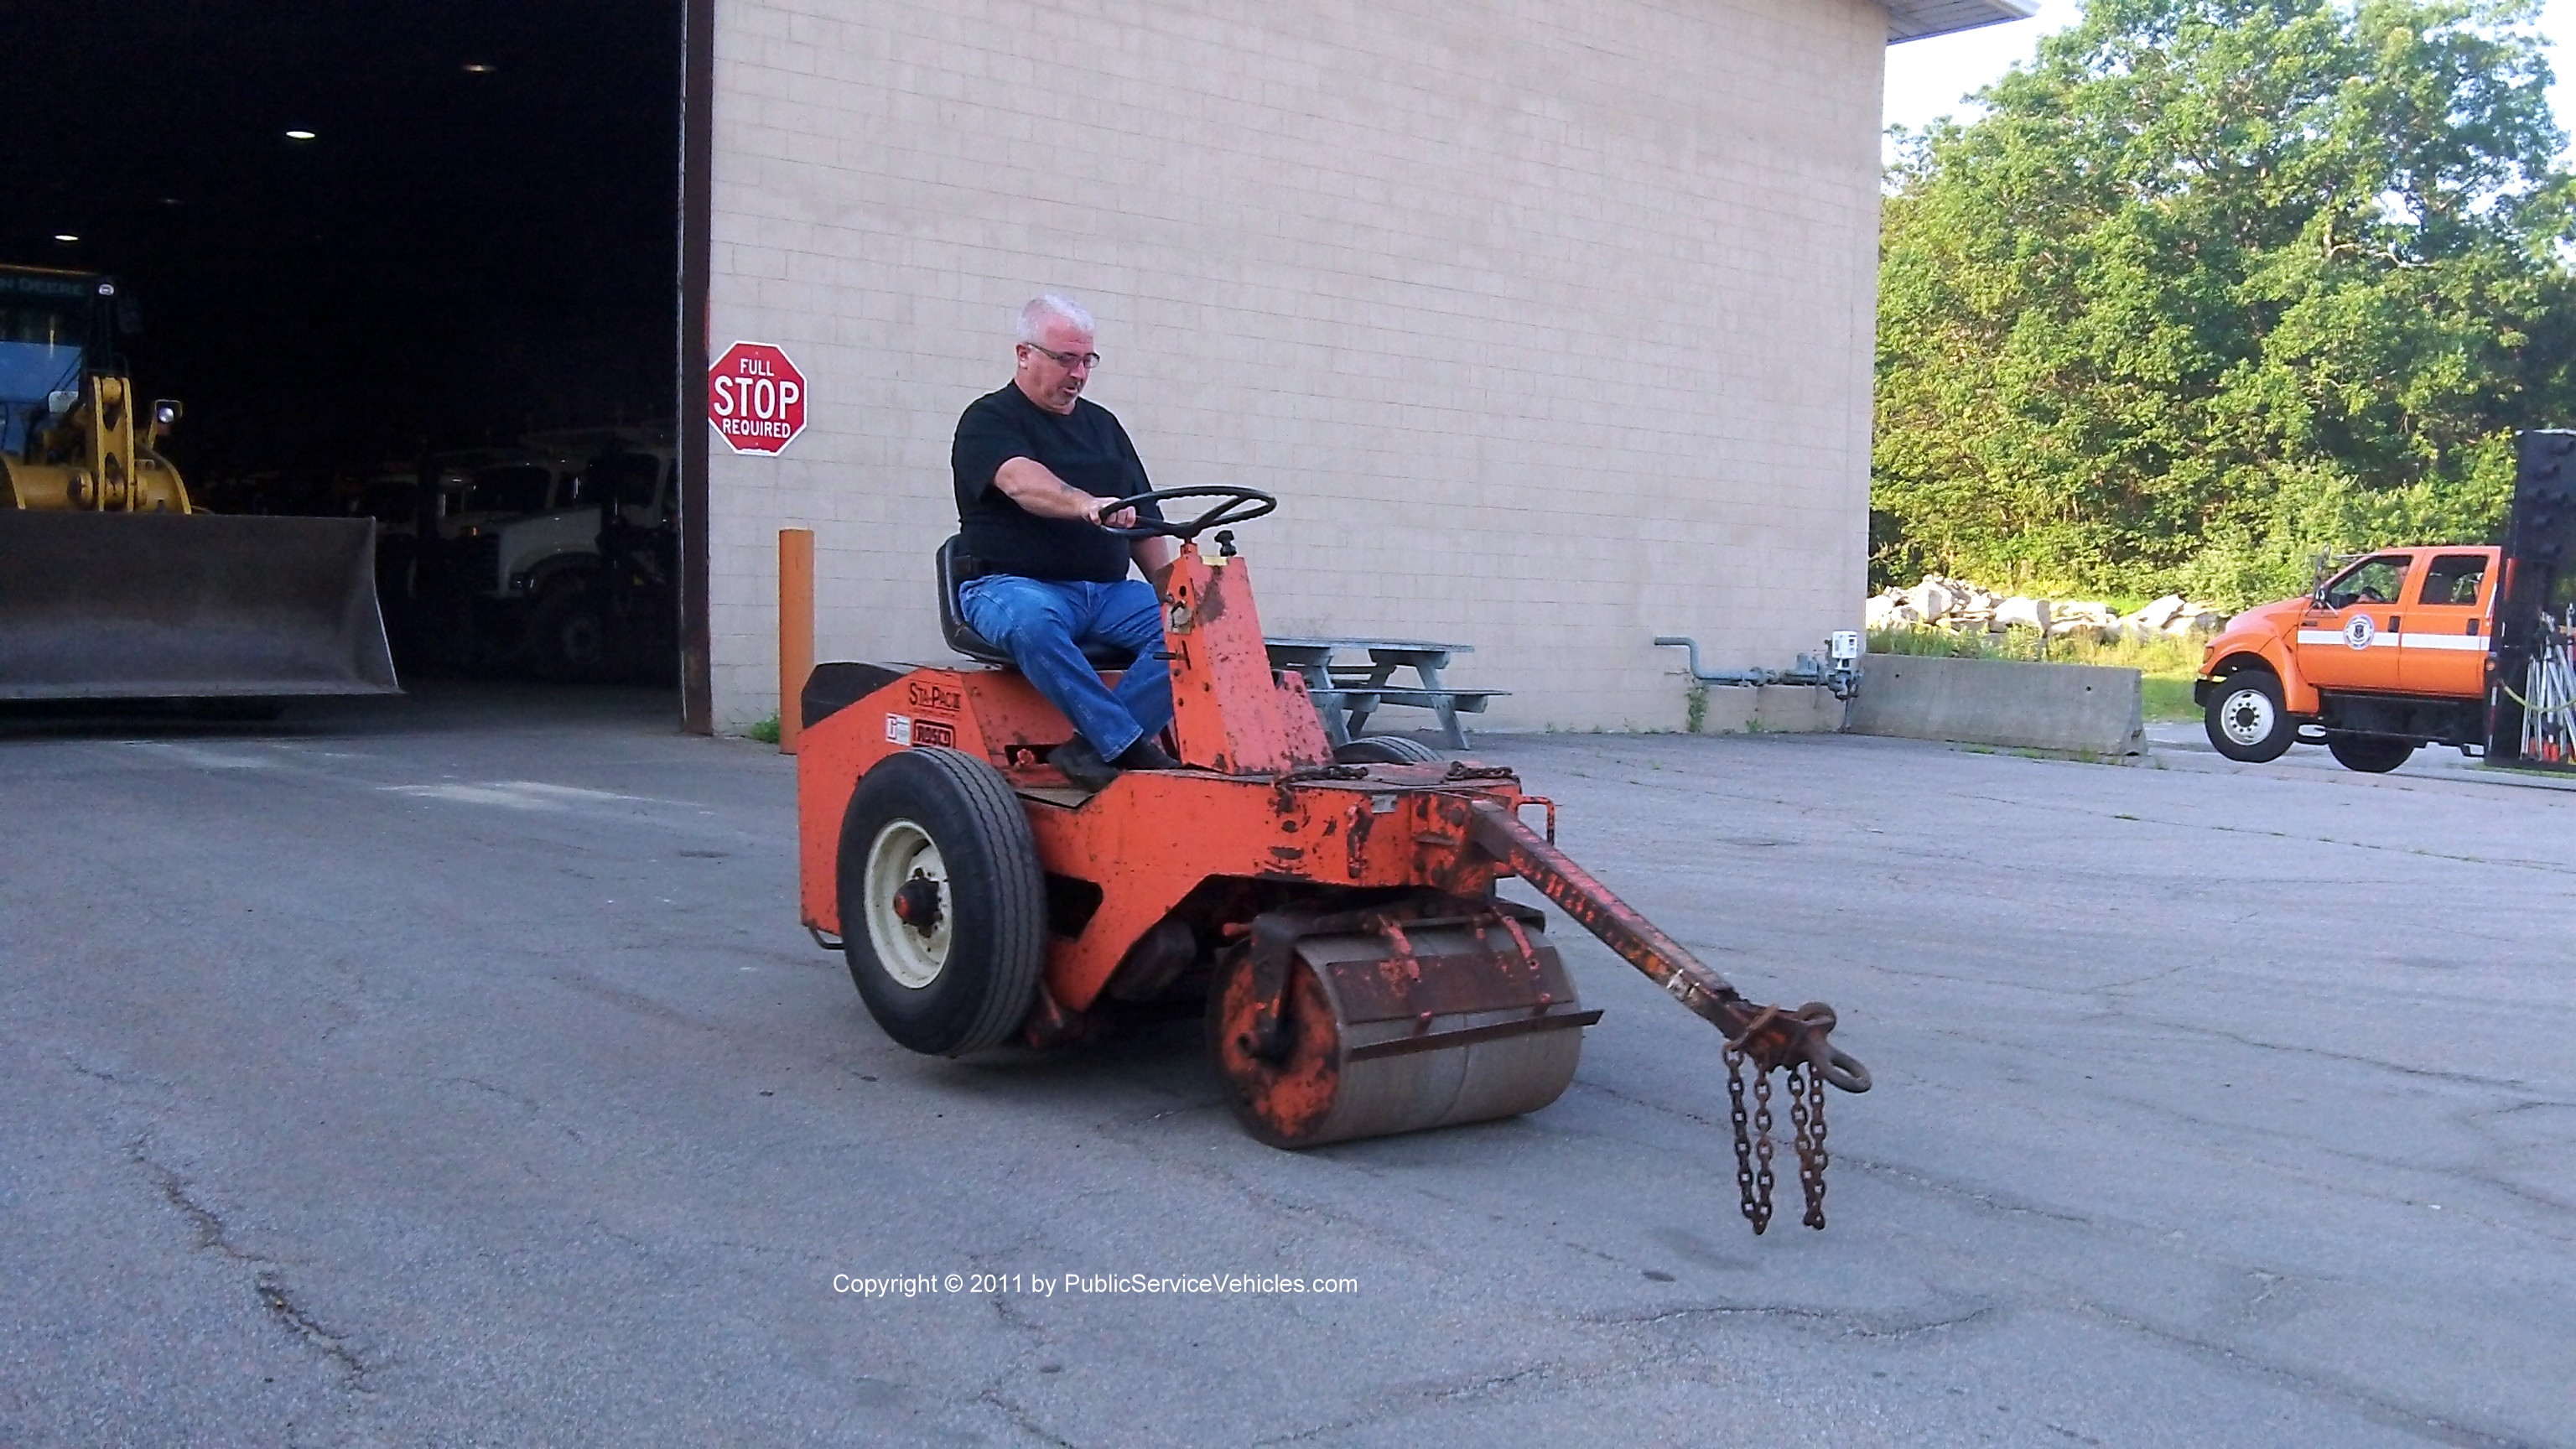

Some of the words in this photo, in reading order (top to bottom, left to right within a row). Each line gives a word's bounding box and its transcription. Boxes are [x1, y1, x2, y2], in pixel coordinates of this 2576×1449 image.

[740, 358, 774, 377] FULL
[714, 376, 799, 419] STOP
[723, 418, 791, 439] REQUIRED
